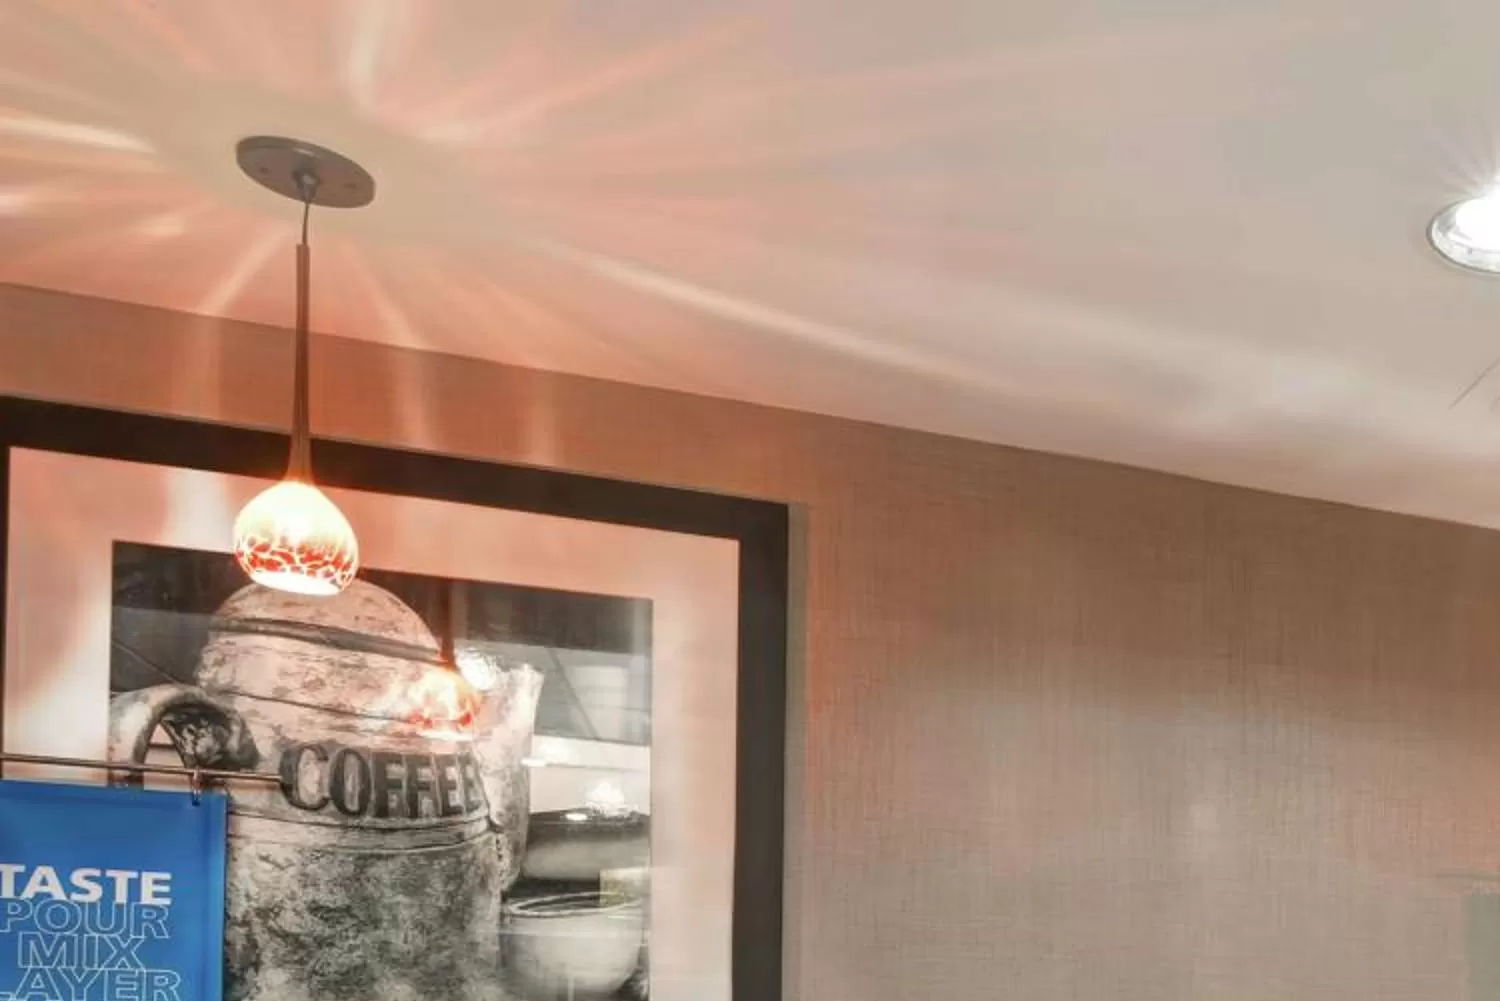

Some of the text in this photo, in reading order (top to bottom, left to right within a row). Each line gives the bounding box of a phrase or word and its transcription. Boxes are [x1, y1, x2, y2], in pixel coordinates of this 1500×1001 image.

[279, 745, 486, 818] COFFEE
[0, 863, 172, 906] TASTE
[0, 898, 169, 939] POUR
[17, 931, 145, 970] MIX
